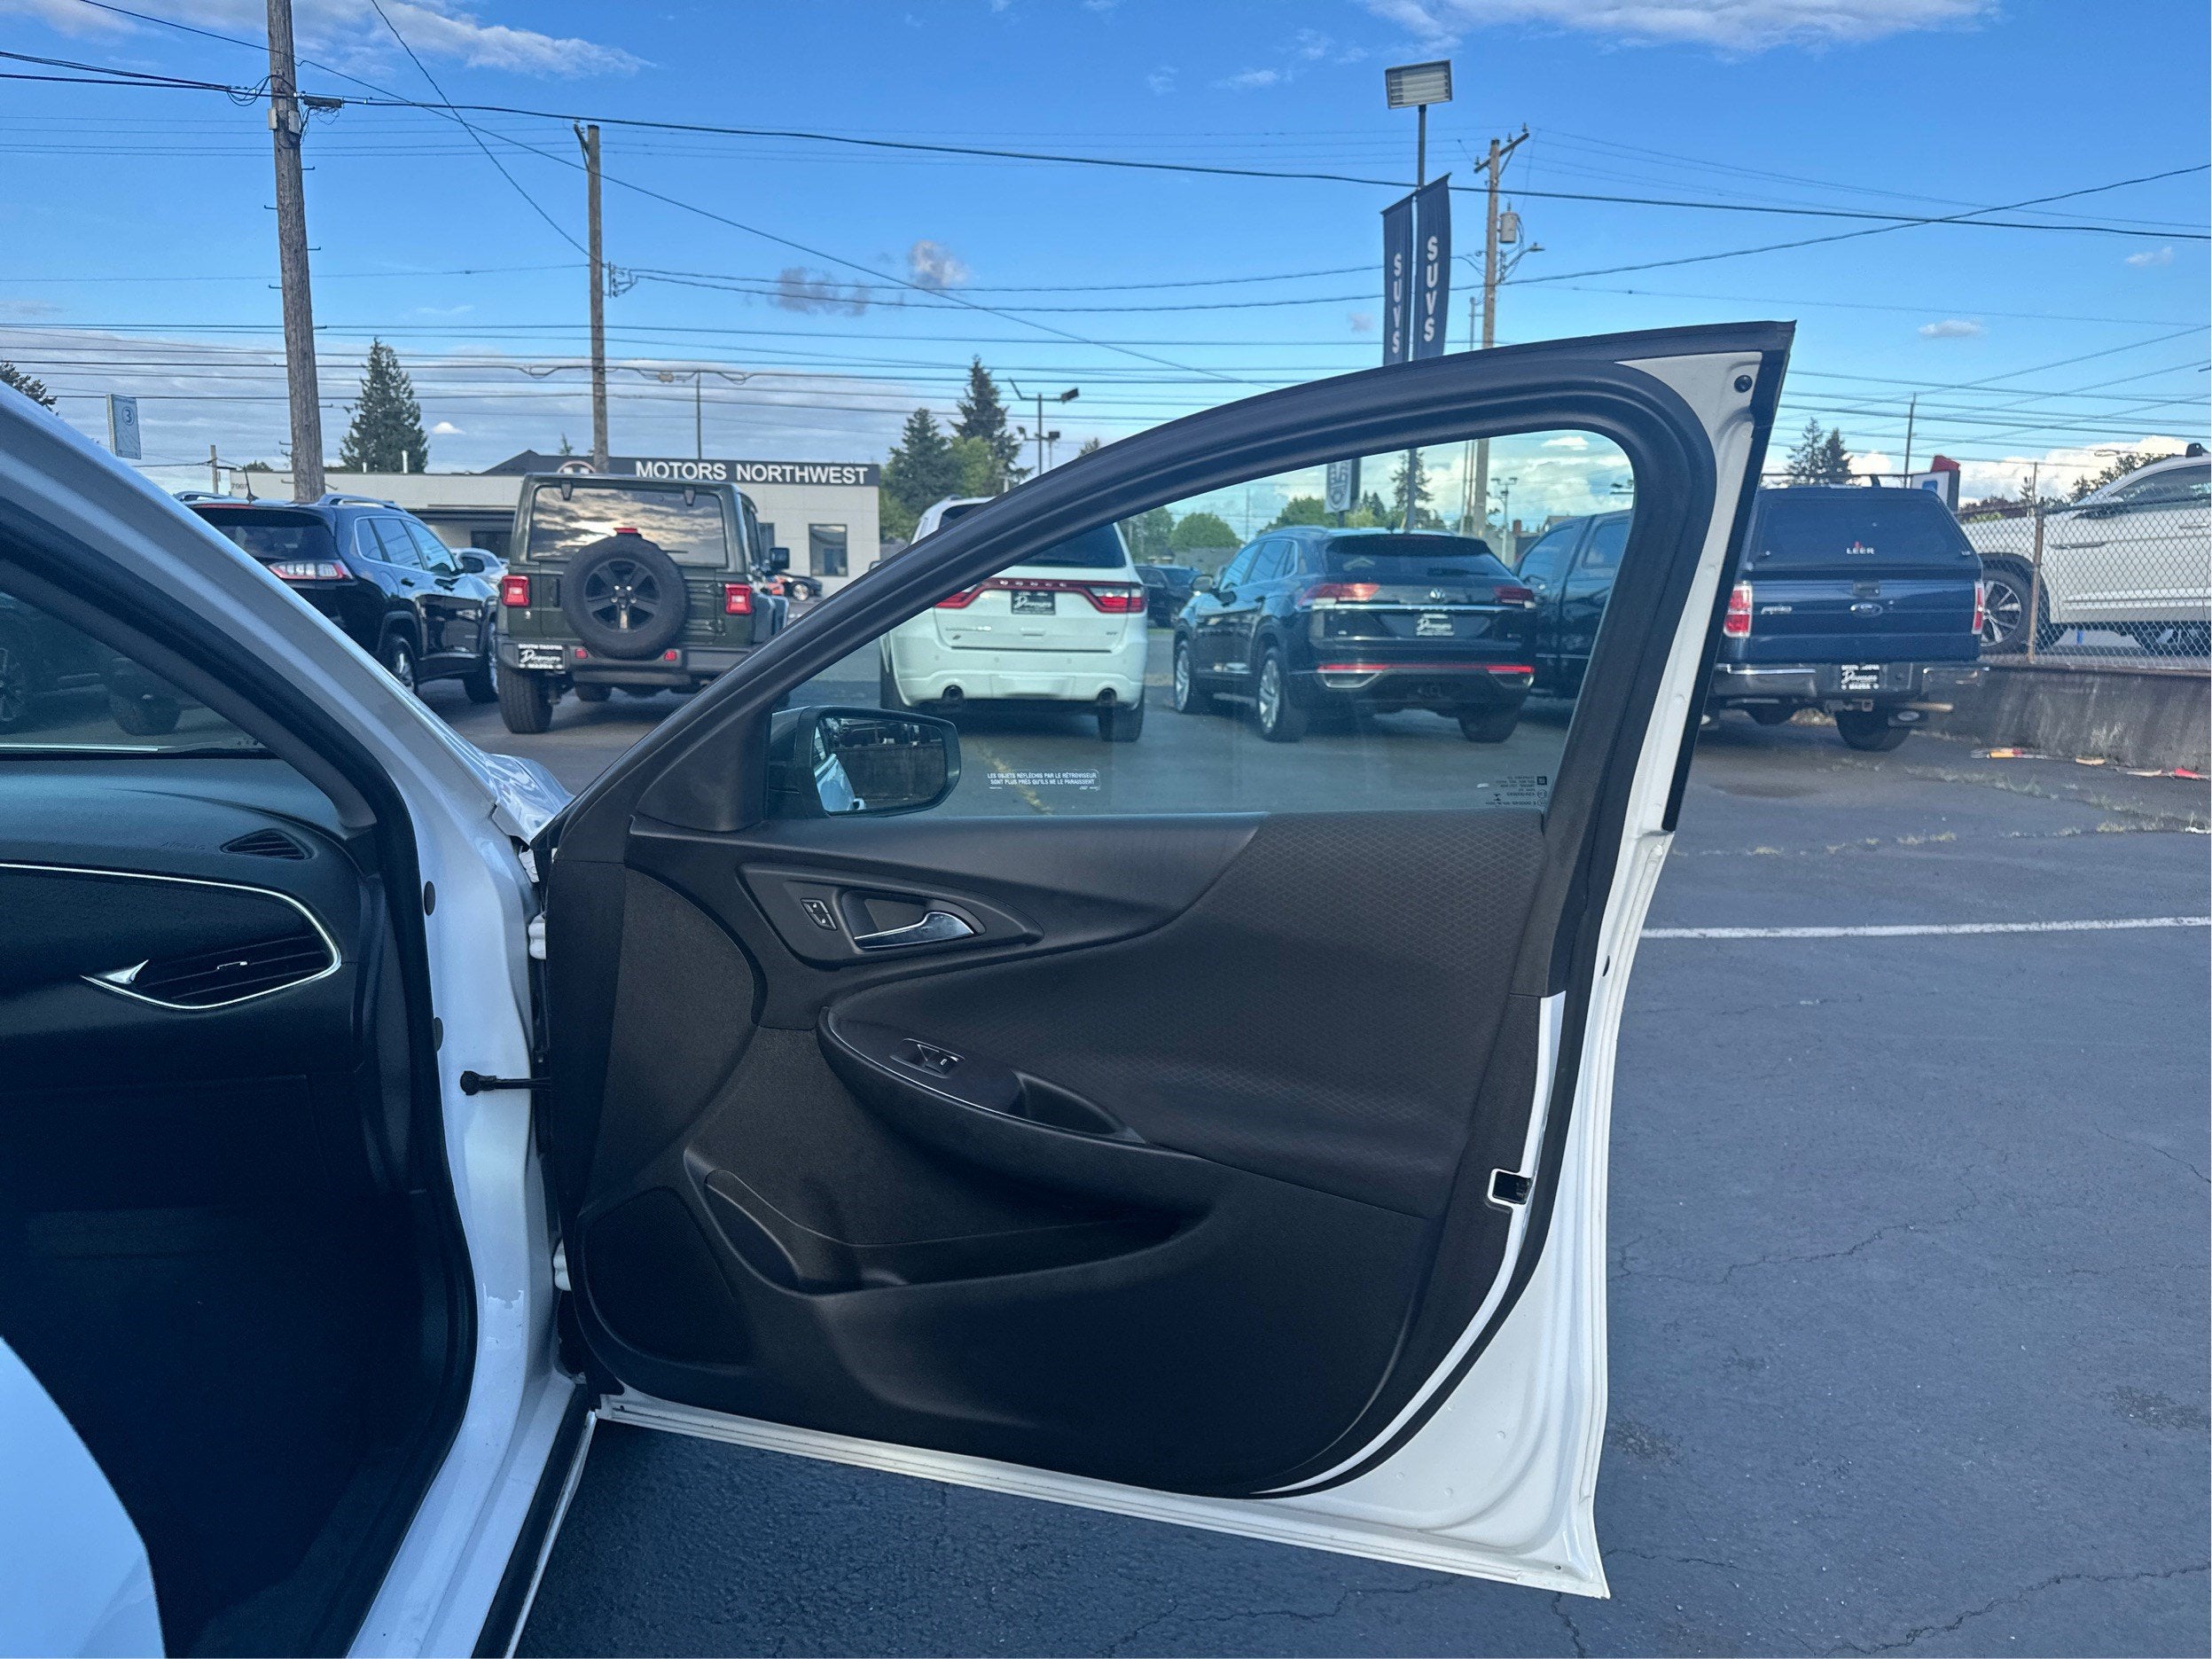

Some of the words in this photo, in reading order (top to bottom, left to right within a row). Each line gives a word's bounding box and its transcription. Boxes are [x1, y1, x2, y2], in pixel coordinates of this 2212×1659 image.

[1392, 253, 1403, 354] SUVS
[1423, 236, 1439, 342] SUVS
[124, 409, 133, 424] 3
[635, 460, 727, 481] MOTORS
[735, 463, 869, 485] NORTHWEST
